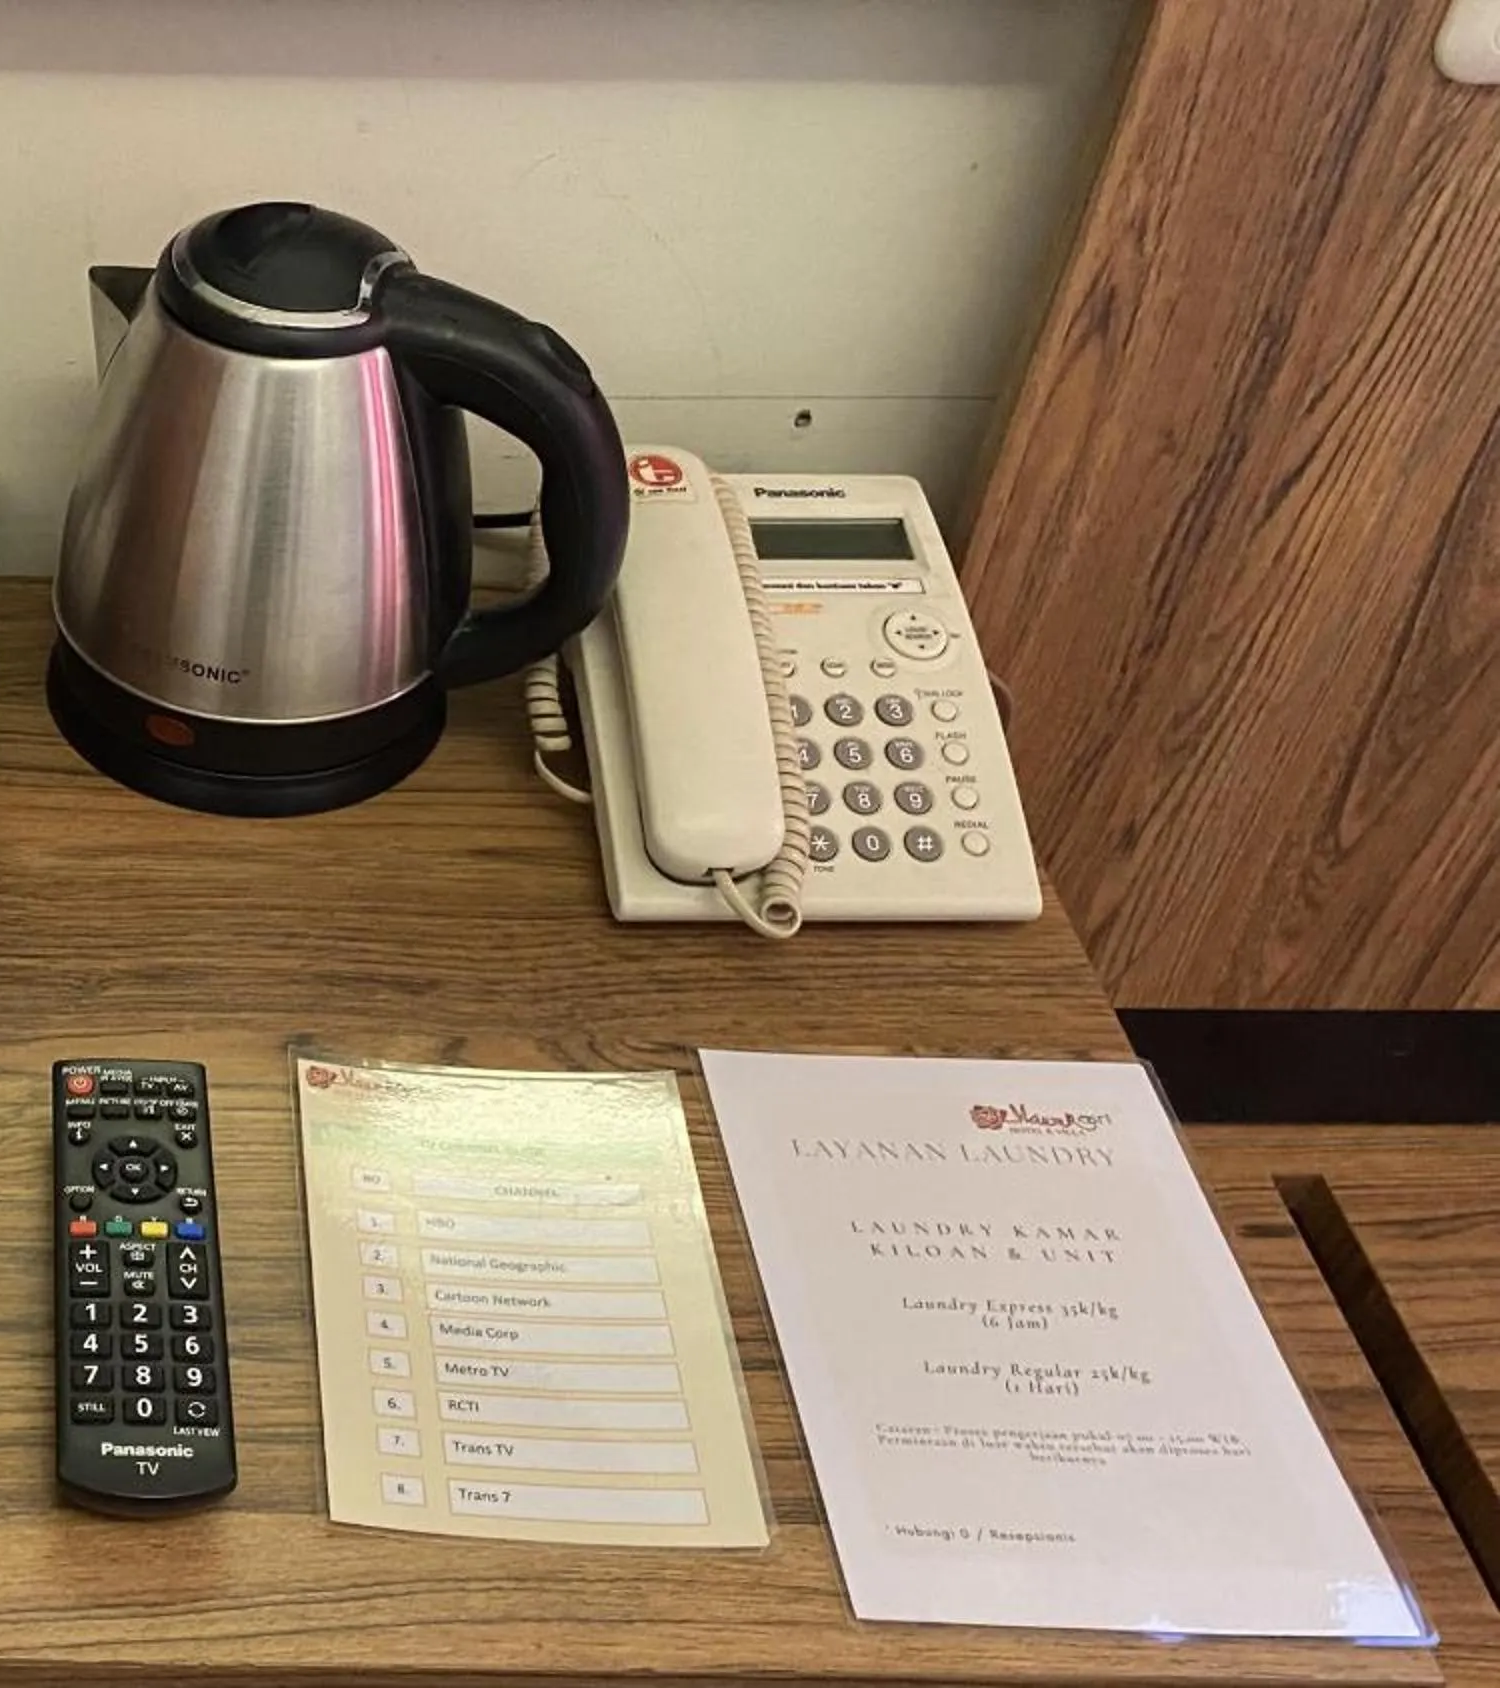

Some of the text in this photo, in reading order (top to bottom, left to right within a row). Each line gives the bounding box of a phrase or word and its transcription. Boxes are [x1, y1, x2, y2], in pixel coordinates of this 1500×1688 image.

[753, 486, 846, 499] Panasonic
[839, 704, 853, 719] 2
[889, 703, 903, 719] 3
[849, 747, 862, 763] 5
[900, 747, 914, 763] 6
[945, 775, 977, 784] PAUSE
[806, 793, 819, 808] 7
[857, 793, 871, 809] 8
[909, 792, 923, 809] 9
[954, 820, 989, 830] REDIAL
[866, 835, 880, 851] 0
[61, 1066, 101, 1075] POWER
[67, 1121, 92, 1129] INFO
[174, 1123, 197, 1131] EXIT
[791, 1138, 1114, 1168] LAYANAN LAUNDRY
[125, 1163, 141, 1172] OK
[63, 1185, 95, 1194] OPTION
[851, 1219, 1122, 1242] LAUNDRY KAMAR
[119, 1243, 157, 1251] ASPECT
[869, 1242, 1117, 1264] KILOAN & UNIT
[75, 1263, 103, 1273] VOL
[179, 1263, 197, 1273] CH
[430, 1253, 486, 1269] National
[489, 1257, 566, 1276] Geographic
[123, 1271, 154, 1280] MUTE
[377, 1282, 551, 1308] 3. Cartoon Network
[85, 1303, 96, 1321] 1
[133, 1304, 148, 1323] 2
[183, 1305, 198, 1324] 3
[901, 1297, 978, 1316] Laundry
[986, 1299, 1053, 1317] Express
[1006, 1316, 1049, 1331] Jam)
[439, 1323, 483, 1337] Media
[485, 1326, 519, 1342] Corp
[83, 1333, 98, 1352] 4
[135, 1334, 148, 1353] 5
[185, 1336, 200, 1355] 6
[83, 1365, 98, 1384] 7
[383, 1357, 510, 1377] 5. Metro TV
[923, 1360, 1002, 1378] Laundry
[1010, 1363, 1080, 1381] Regular
[136, 1366, 151, 1385] 8
[187, 1368, 202, 1387] 9
[1029, 1381, 1079, 1397] Hari)
[77, 1403, 105, 1412] STILL
[137, 1398, 152, 1418] 0
[387, 1397, 480, 1413] 6. RCTI
[101, 1442, 194, 1458] Panasonic
[452, 1440, 492, 1456] Trans
[495, 1444, 514, 1457] TV
[136, 1462, 160, 1476] TV
[458, 1487, 499, 1502] Trans
[502, 1491, 511, 1504] 7
[894, 1524, 955, 1541] Hubungi
